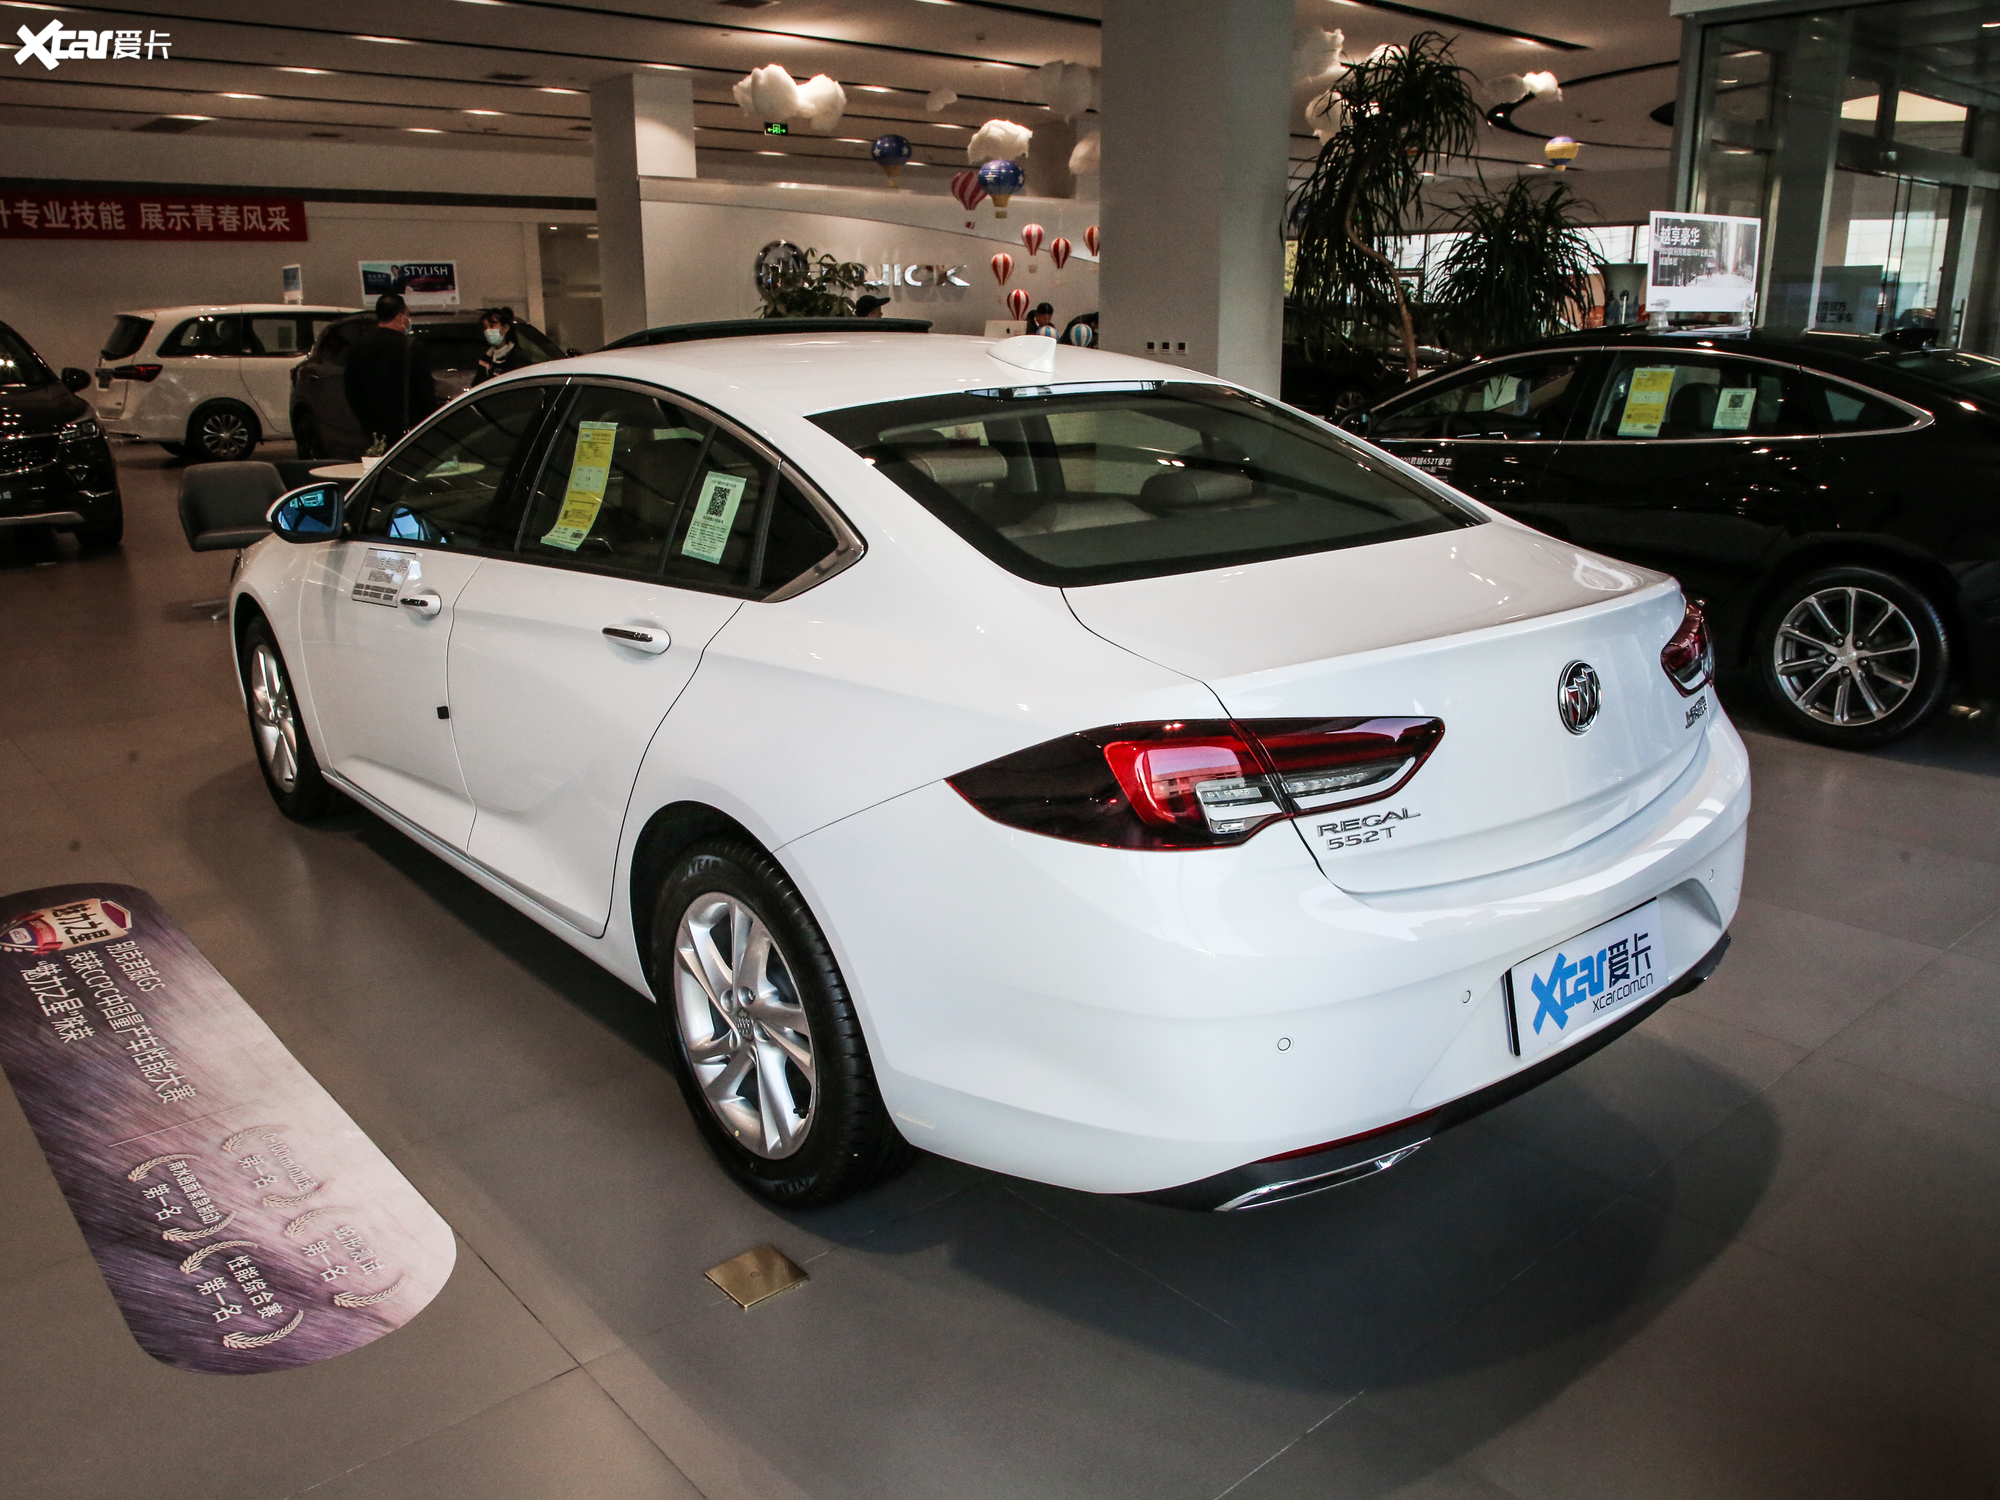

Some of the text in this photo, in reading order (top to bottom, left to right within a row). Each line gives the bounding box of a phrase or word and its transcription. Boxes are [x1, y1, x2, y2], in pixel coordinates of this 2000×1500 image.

[140, 203, 290, 232] 展示青春风采
[1660, 226, 1700, 246] 越享豪华
[404, 266, 448, 276] STYLISH
[1316, 807, 1421, 837] REGAL
[1327, 825, 1396, 850] 552T
[51, 902, 111, 945] 魅力之星
[105, 940, 166, 993] 别克君威GS
[65, 950, 197, 1104] 荣获CCPC中国量产车性能大赛
[167, 1160, 223, 1225] 雨水路面紧急制动
[238, 1154, 279, 1189] 第一名
[142, 1183, 183, 1222] 第一名
[301, 1240, 350, 1282] 第一名
[332, 1225, 386, 1276] 蛇形测试
[196, 1276, 243, 1323] 第一名
[226, 1255, 284, 1319] 性能综合赛
